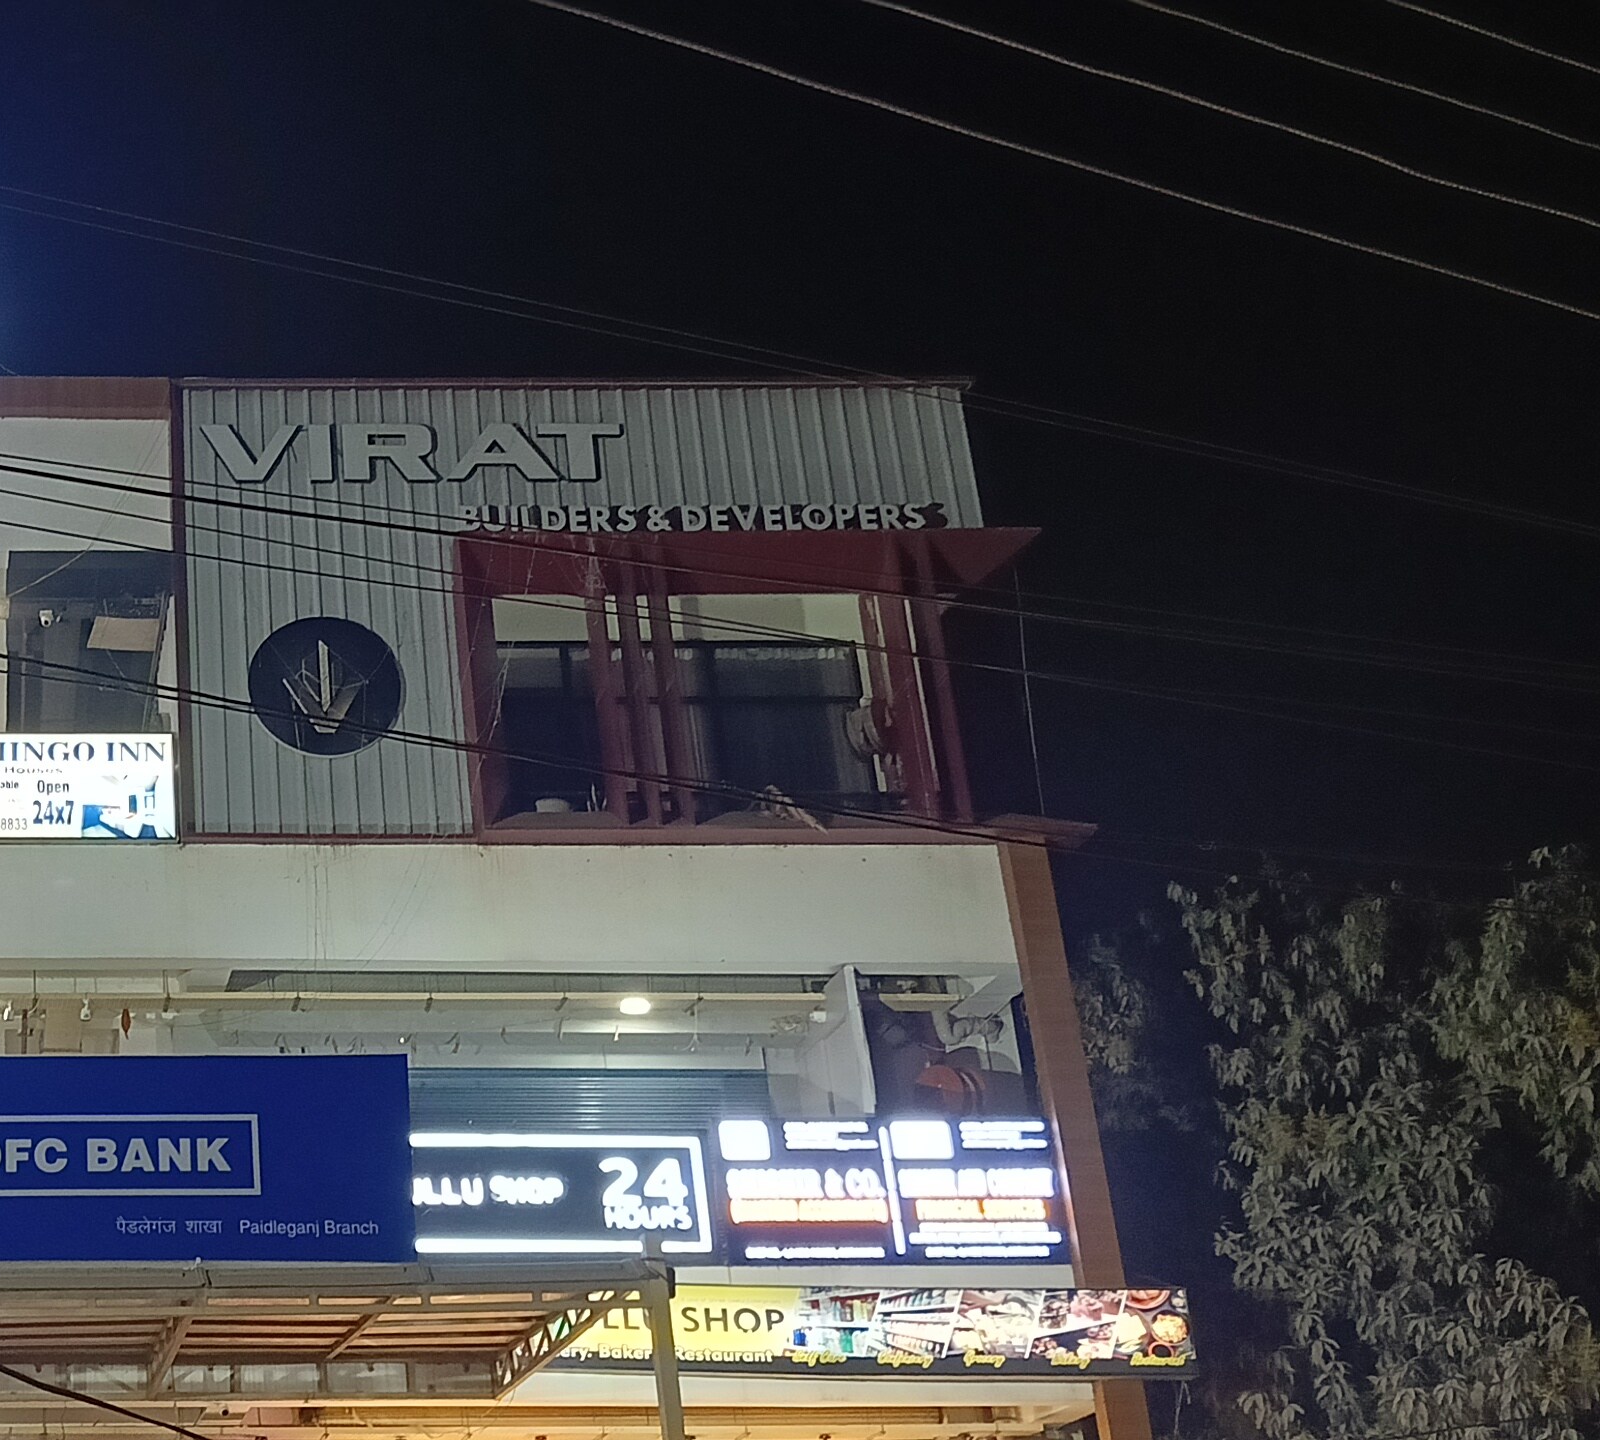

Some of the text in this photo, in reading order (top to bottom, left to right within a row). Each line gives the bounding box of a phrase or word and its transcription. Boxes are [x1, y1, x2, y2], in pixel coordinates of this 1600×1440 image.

[199, 422, 624, 483] VIRAT
[459, 503, 927, 532] BUILDERS & DEVELOPERS
[106, 741, 166, 762] INN
[37, 780, 70, 795] Open
[32, 800, 74, 825] 24x7
[85, 1136, 232, 1173] BANK
[598, 1156, 689, 1208] 24
[115, 1215, 223, 1234] पैडलेगंज शाखा
[239, 1219, 379, 1238] Paidleganj Branch
[681, 1306, 785, 1333] SHOP
